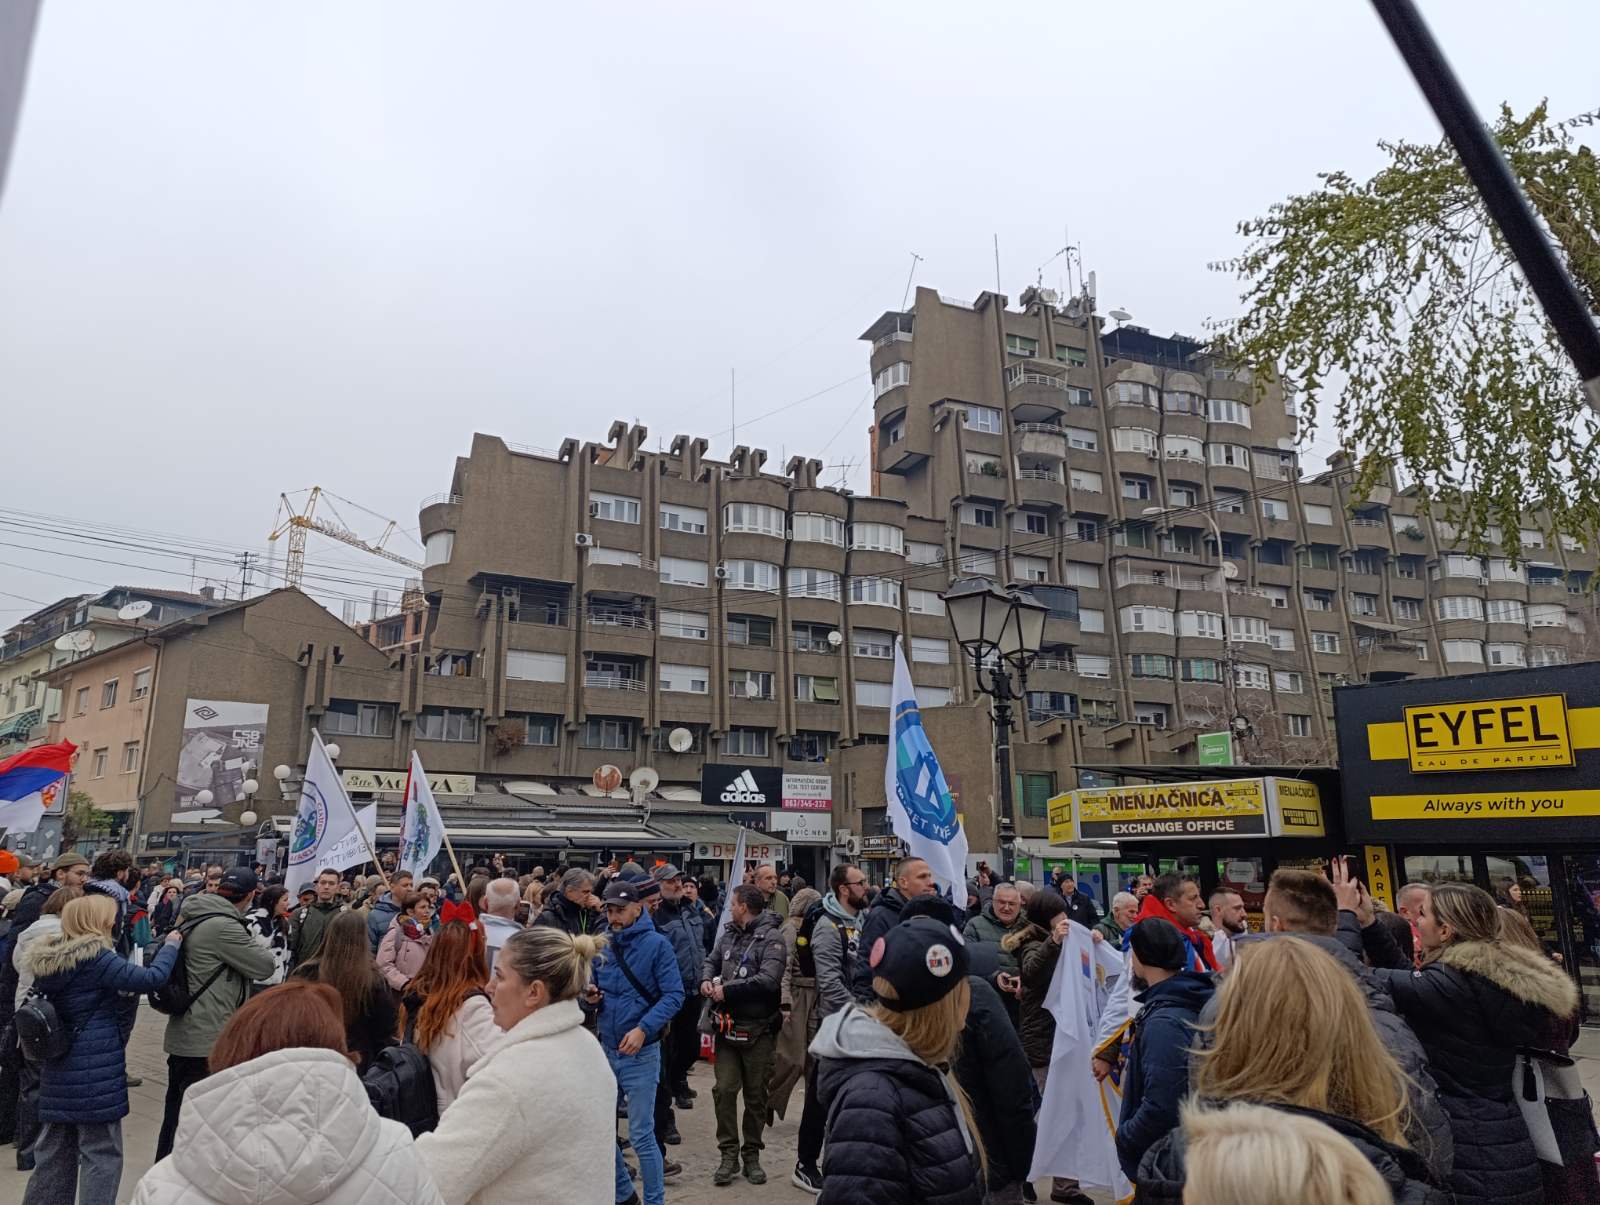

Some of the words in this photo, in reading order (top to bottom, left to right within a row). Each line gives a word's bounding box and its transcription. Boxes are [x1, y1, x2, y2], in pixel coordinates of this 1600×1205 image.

[1412, 705, 1560, 748] EYFEL
[1493, 754, 1564, 764] PARFUM
[720, 791, 766, 804] adidas
[1110, 789, 1225, 811] MENJAČNICA
[1423, 799, 1483, 814] Always
[1483, 797, 1526, 811] with
[1530, 798, 1564, 813] you
[1112, 821, 1184, 834] EXCHANGE
[1186, 820, 1235, 831] OFFICE
